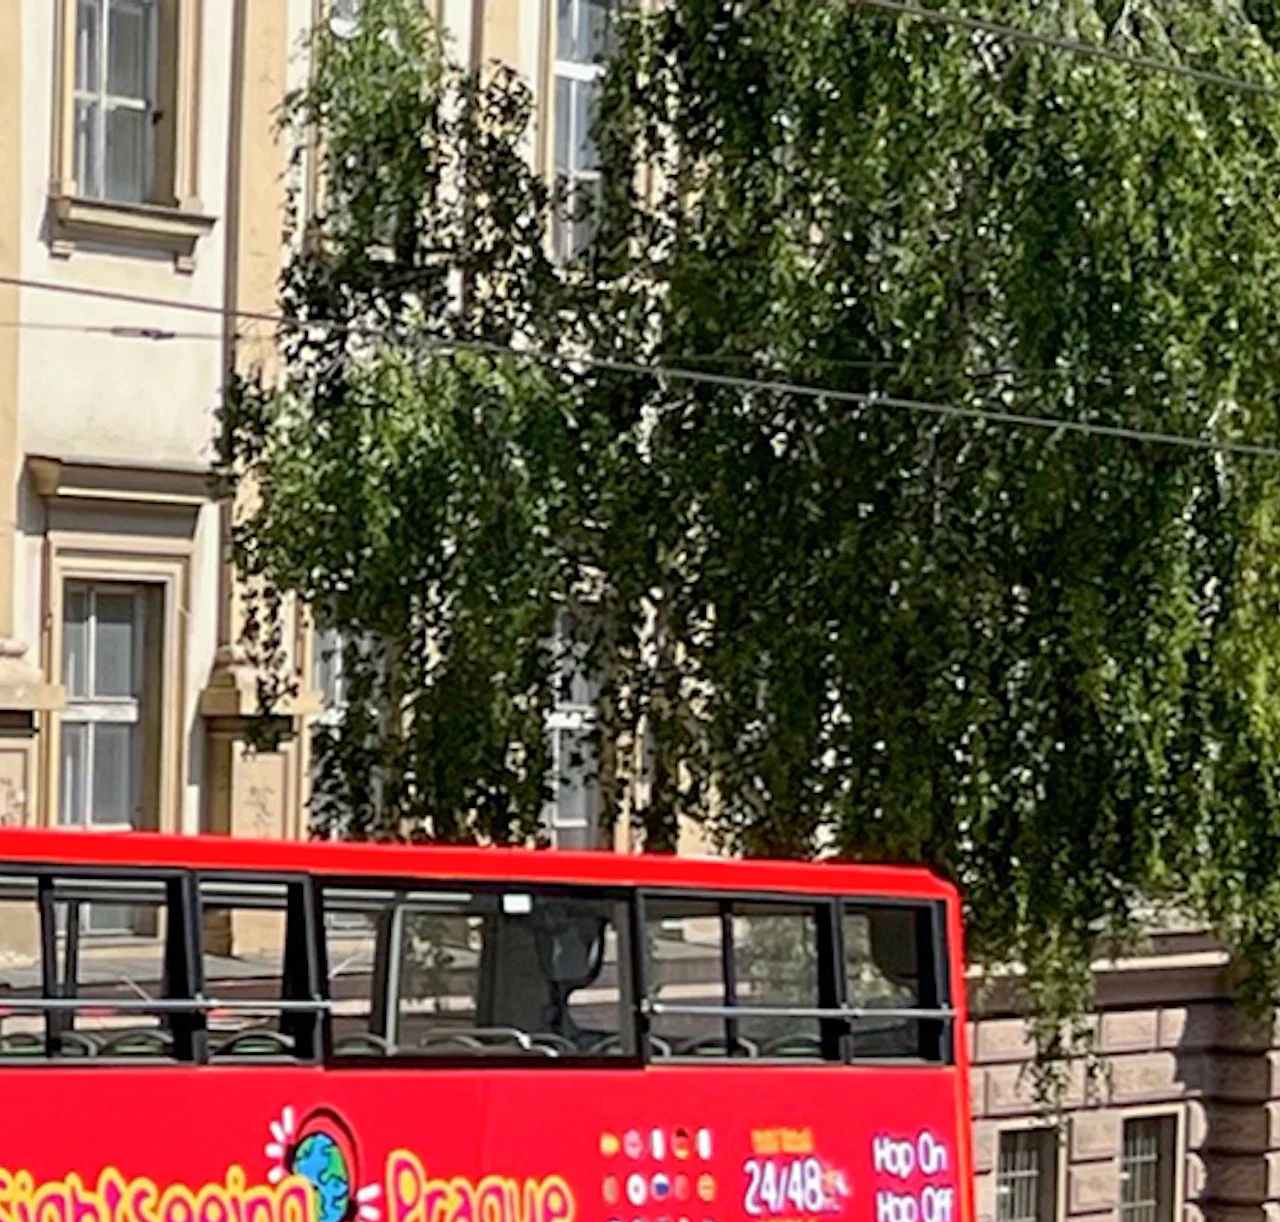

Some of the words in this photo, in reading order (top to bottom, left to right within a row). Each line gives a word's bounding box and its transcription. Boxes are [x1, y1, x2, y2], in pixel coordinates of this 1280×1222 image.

[873, 1137, 914, 1178] Hop
[917, 1131, 948, 1174] On
[744, 1158, 822, 1214] 24/48
